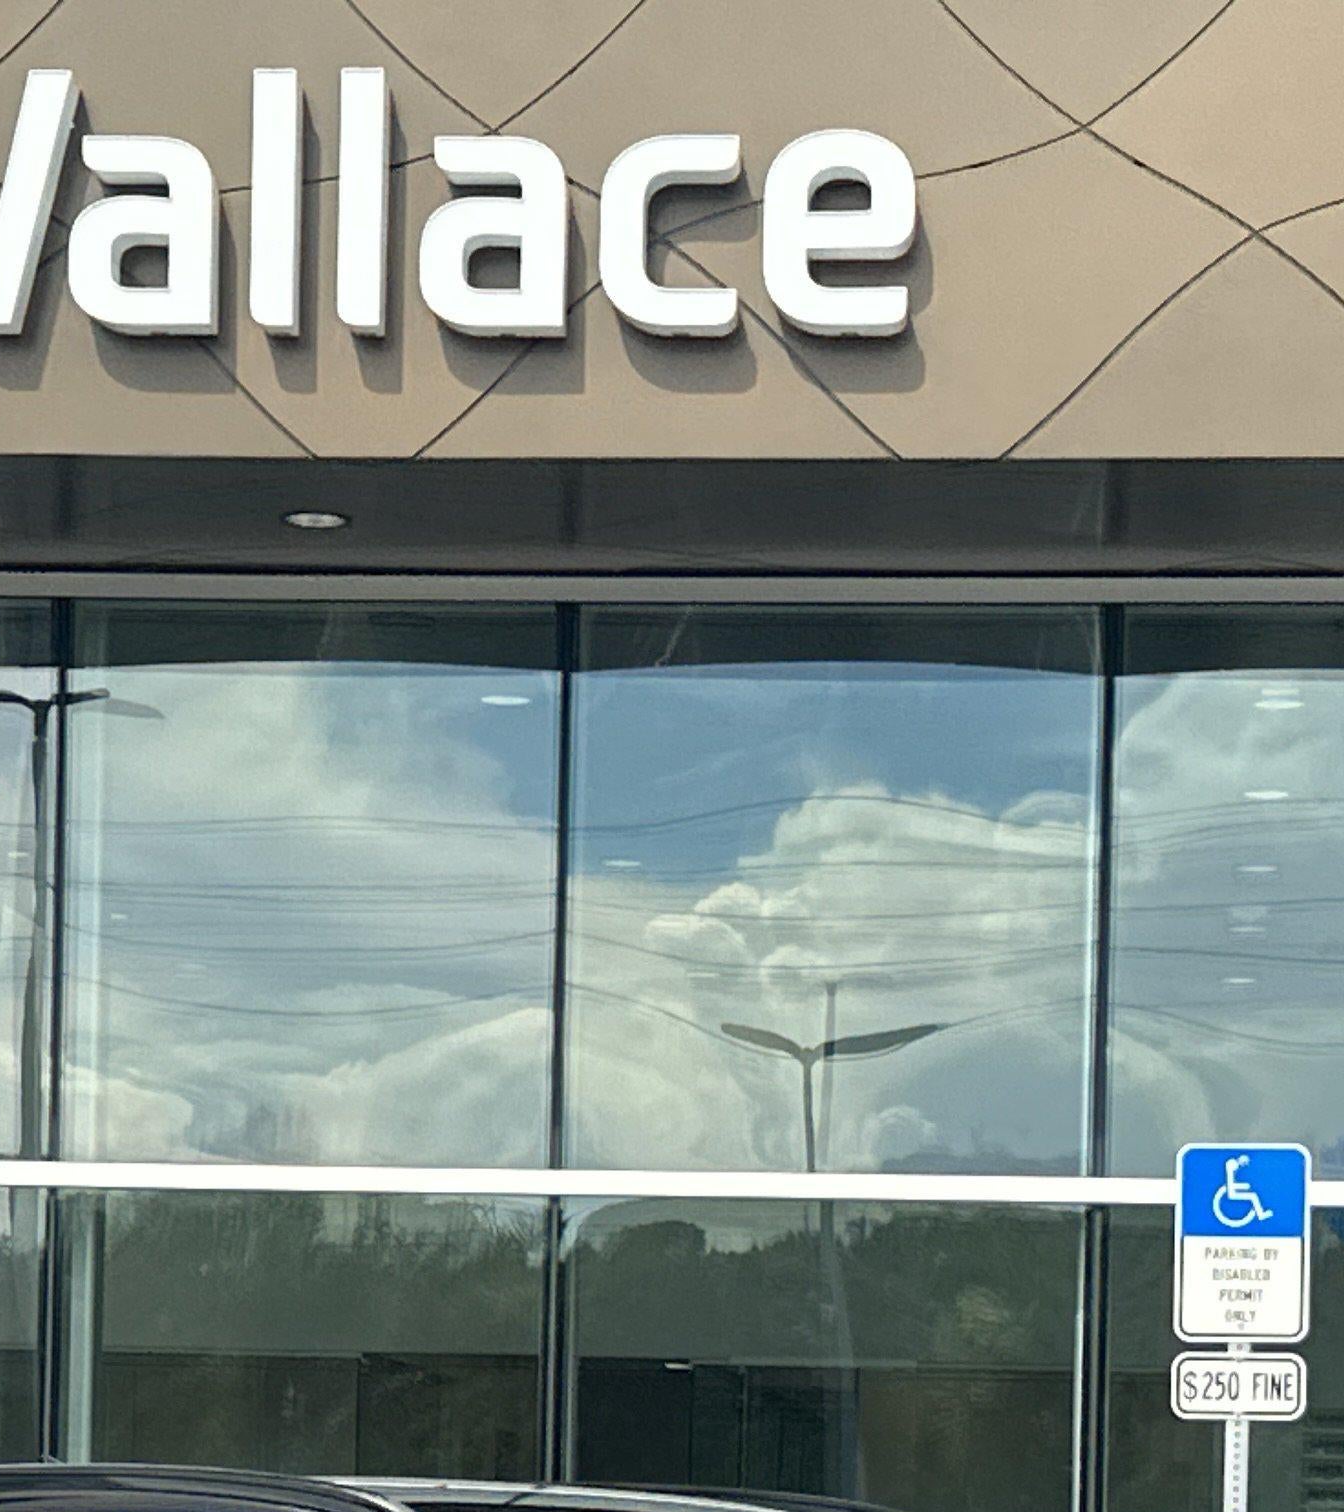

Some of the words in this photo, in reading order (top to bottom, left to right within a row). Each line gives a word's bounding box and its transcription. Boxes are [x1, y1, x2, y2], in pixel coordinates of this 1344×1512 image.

[1204, 1246, 1258, 1261] PARKING
[1263, 1247, 1279, 1261] BY
[1212, 1267, 1271, 1281] DISABLED
[1218, 1288, 1263, 1302] PERMIT
[1224, 1308, 1256, 1323] ONLY
[1182, 1371, 1240, 1403] $250
[1252, 1372, 1295, 1401] FINE
